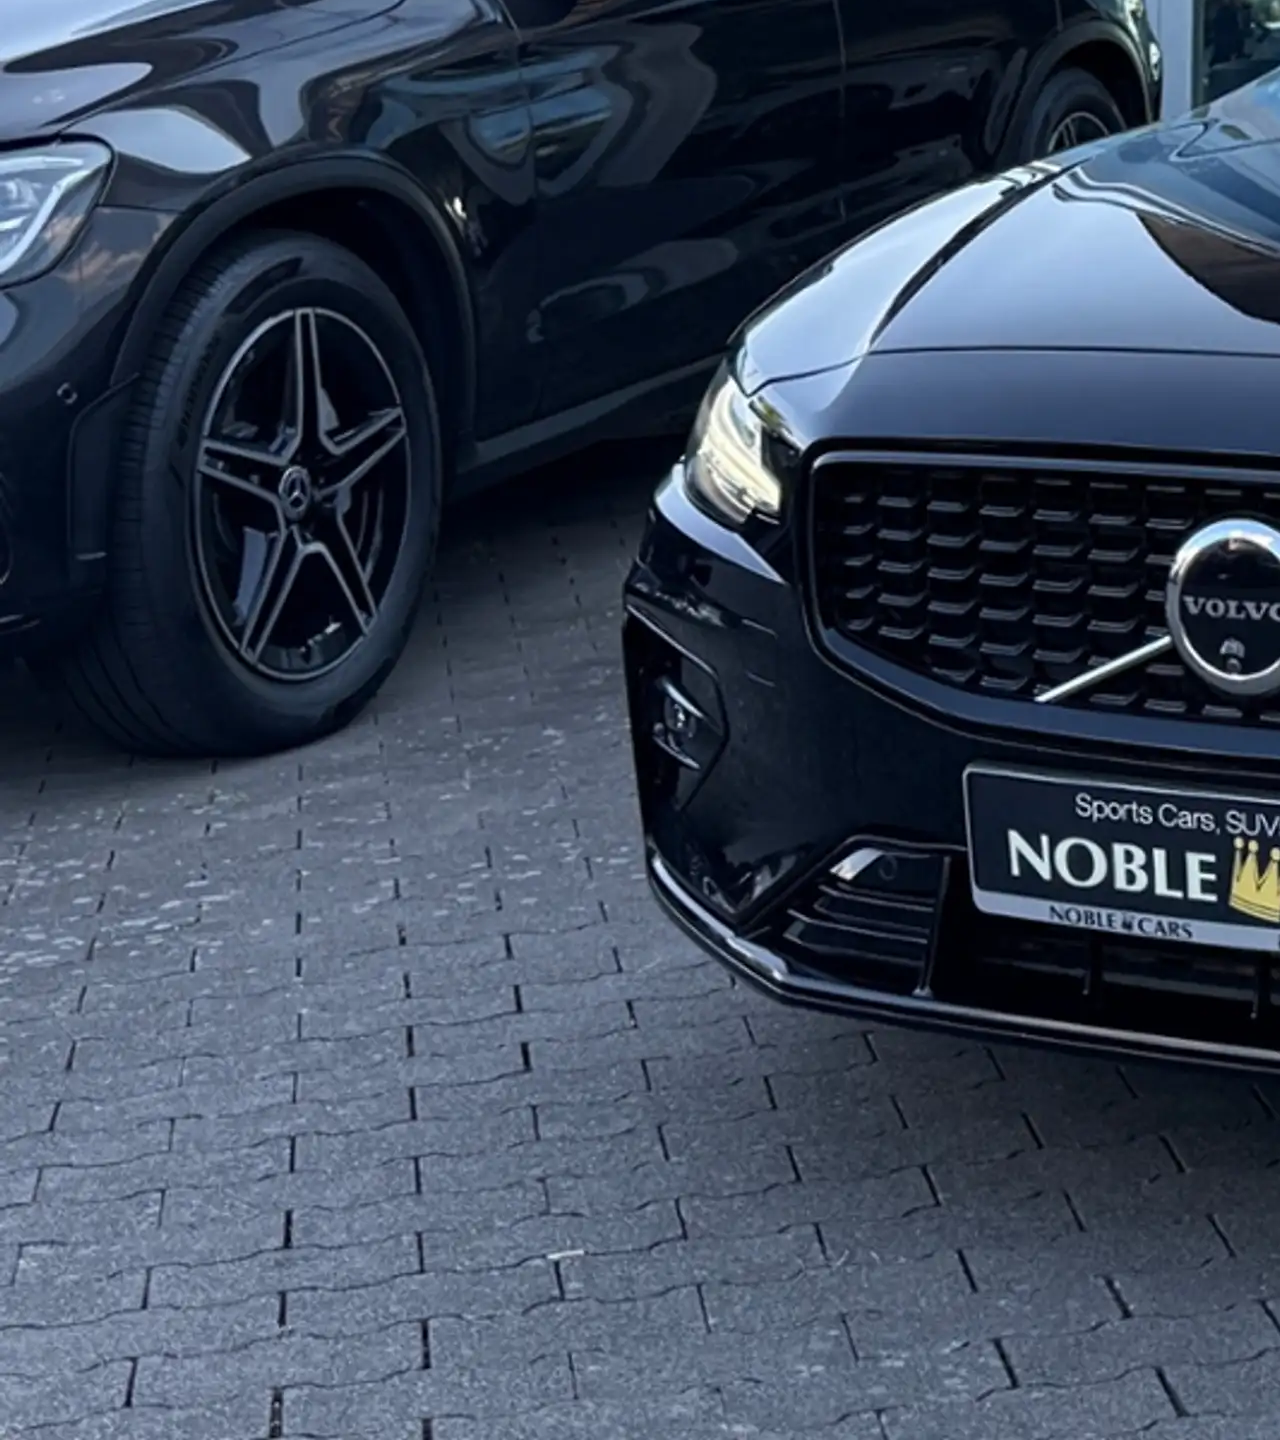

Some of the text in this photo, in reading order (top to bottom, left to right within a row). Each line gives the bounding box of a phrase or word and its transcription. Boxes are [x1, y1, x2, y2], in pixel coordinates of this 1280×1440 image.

[1075, 792, 1153, 825] Sports
[1158, 803, 1221, 835] Cars,
[1007, 829, 1218, 902] NOBLE
[1049, 905, 1194, 939] NOBLE CARS
